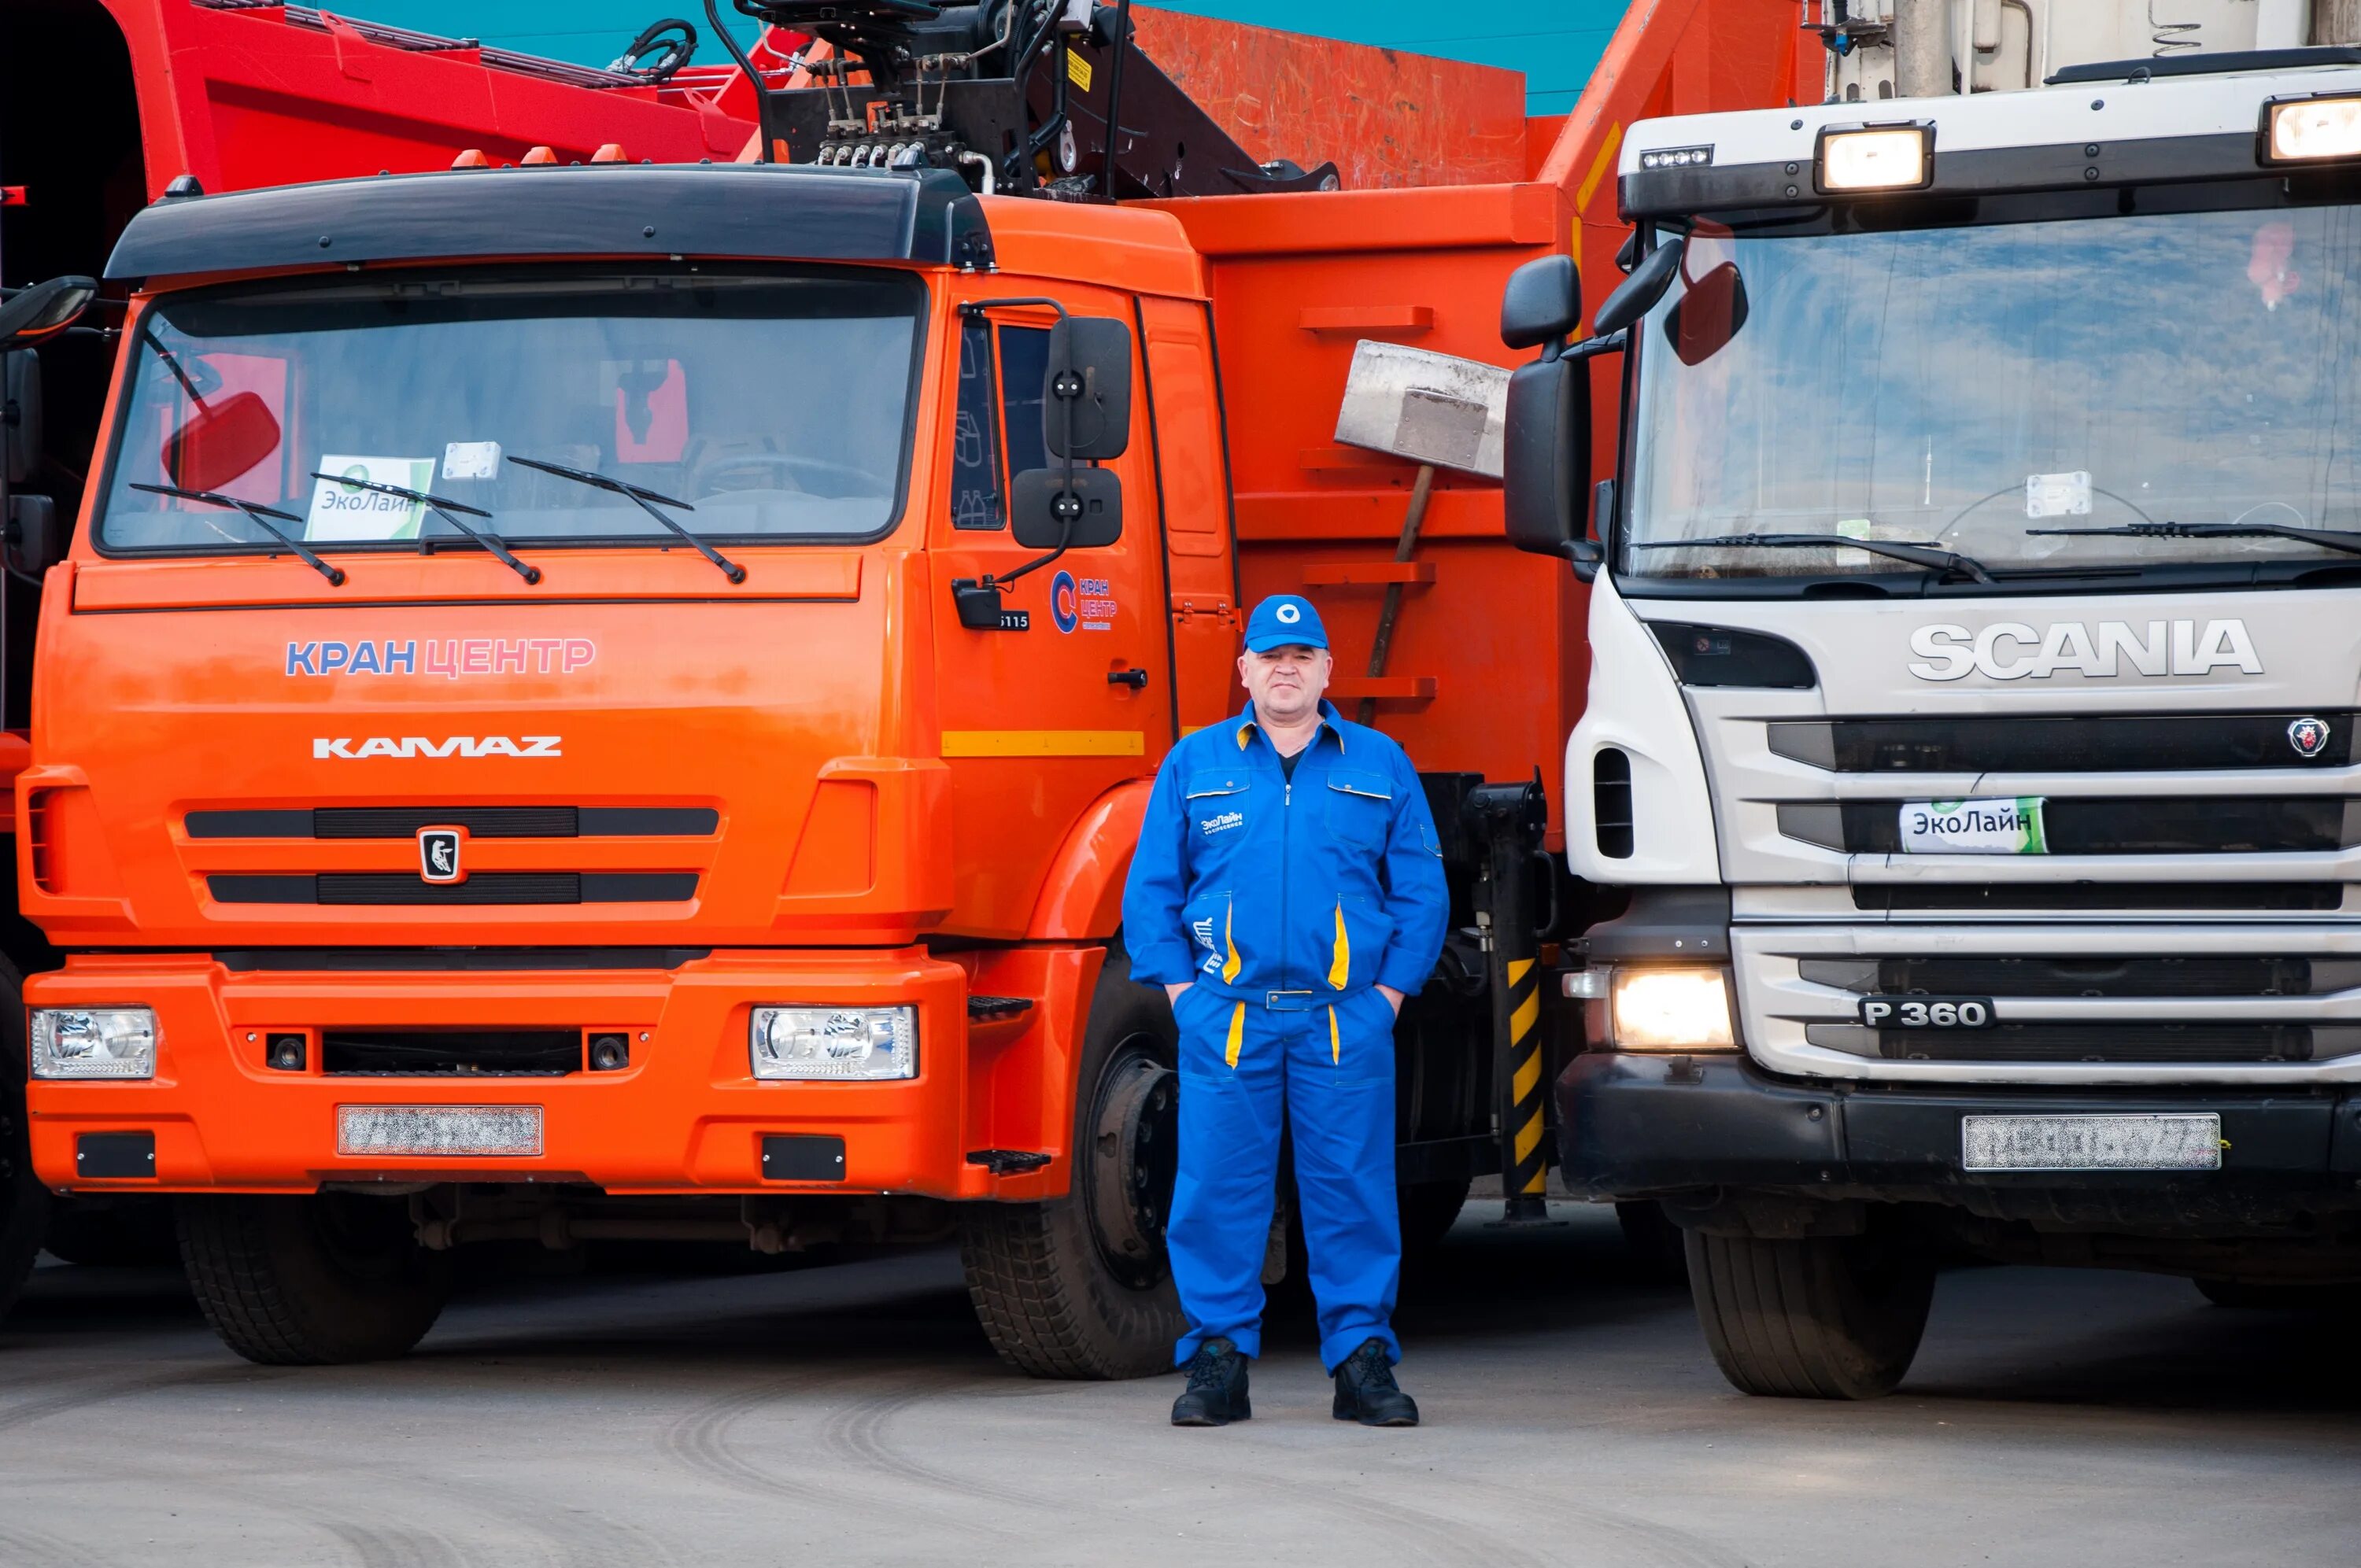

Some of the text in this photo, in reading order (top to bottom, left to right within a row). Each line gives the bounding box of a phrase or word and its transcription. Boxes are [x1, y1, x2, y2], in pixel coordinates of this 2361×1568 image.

[1079, 579, 1109, 596] КРАН
[1081, 600, 1117, 618] ЦЕНТР
[286, 639, 596, 679] КРАН ЦЕНТР
[1907, 618, 2264, 681] SCANIA
[313, 736, 562, 758] KAMAZ
[1201, 812, 1243, 830] ЭкоЛайн
[1913, 807, 2032, 835] ЭкоЛайн
[1865, 1002, 1986, 1026] P 360
